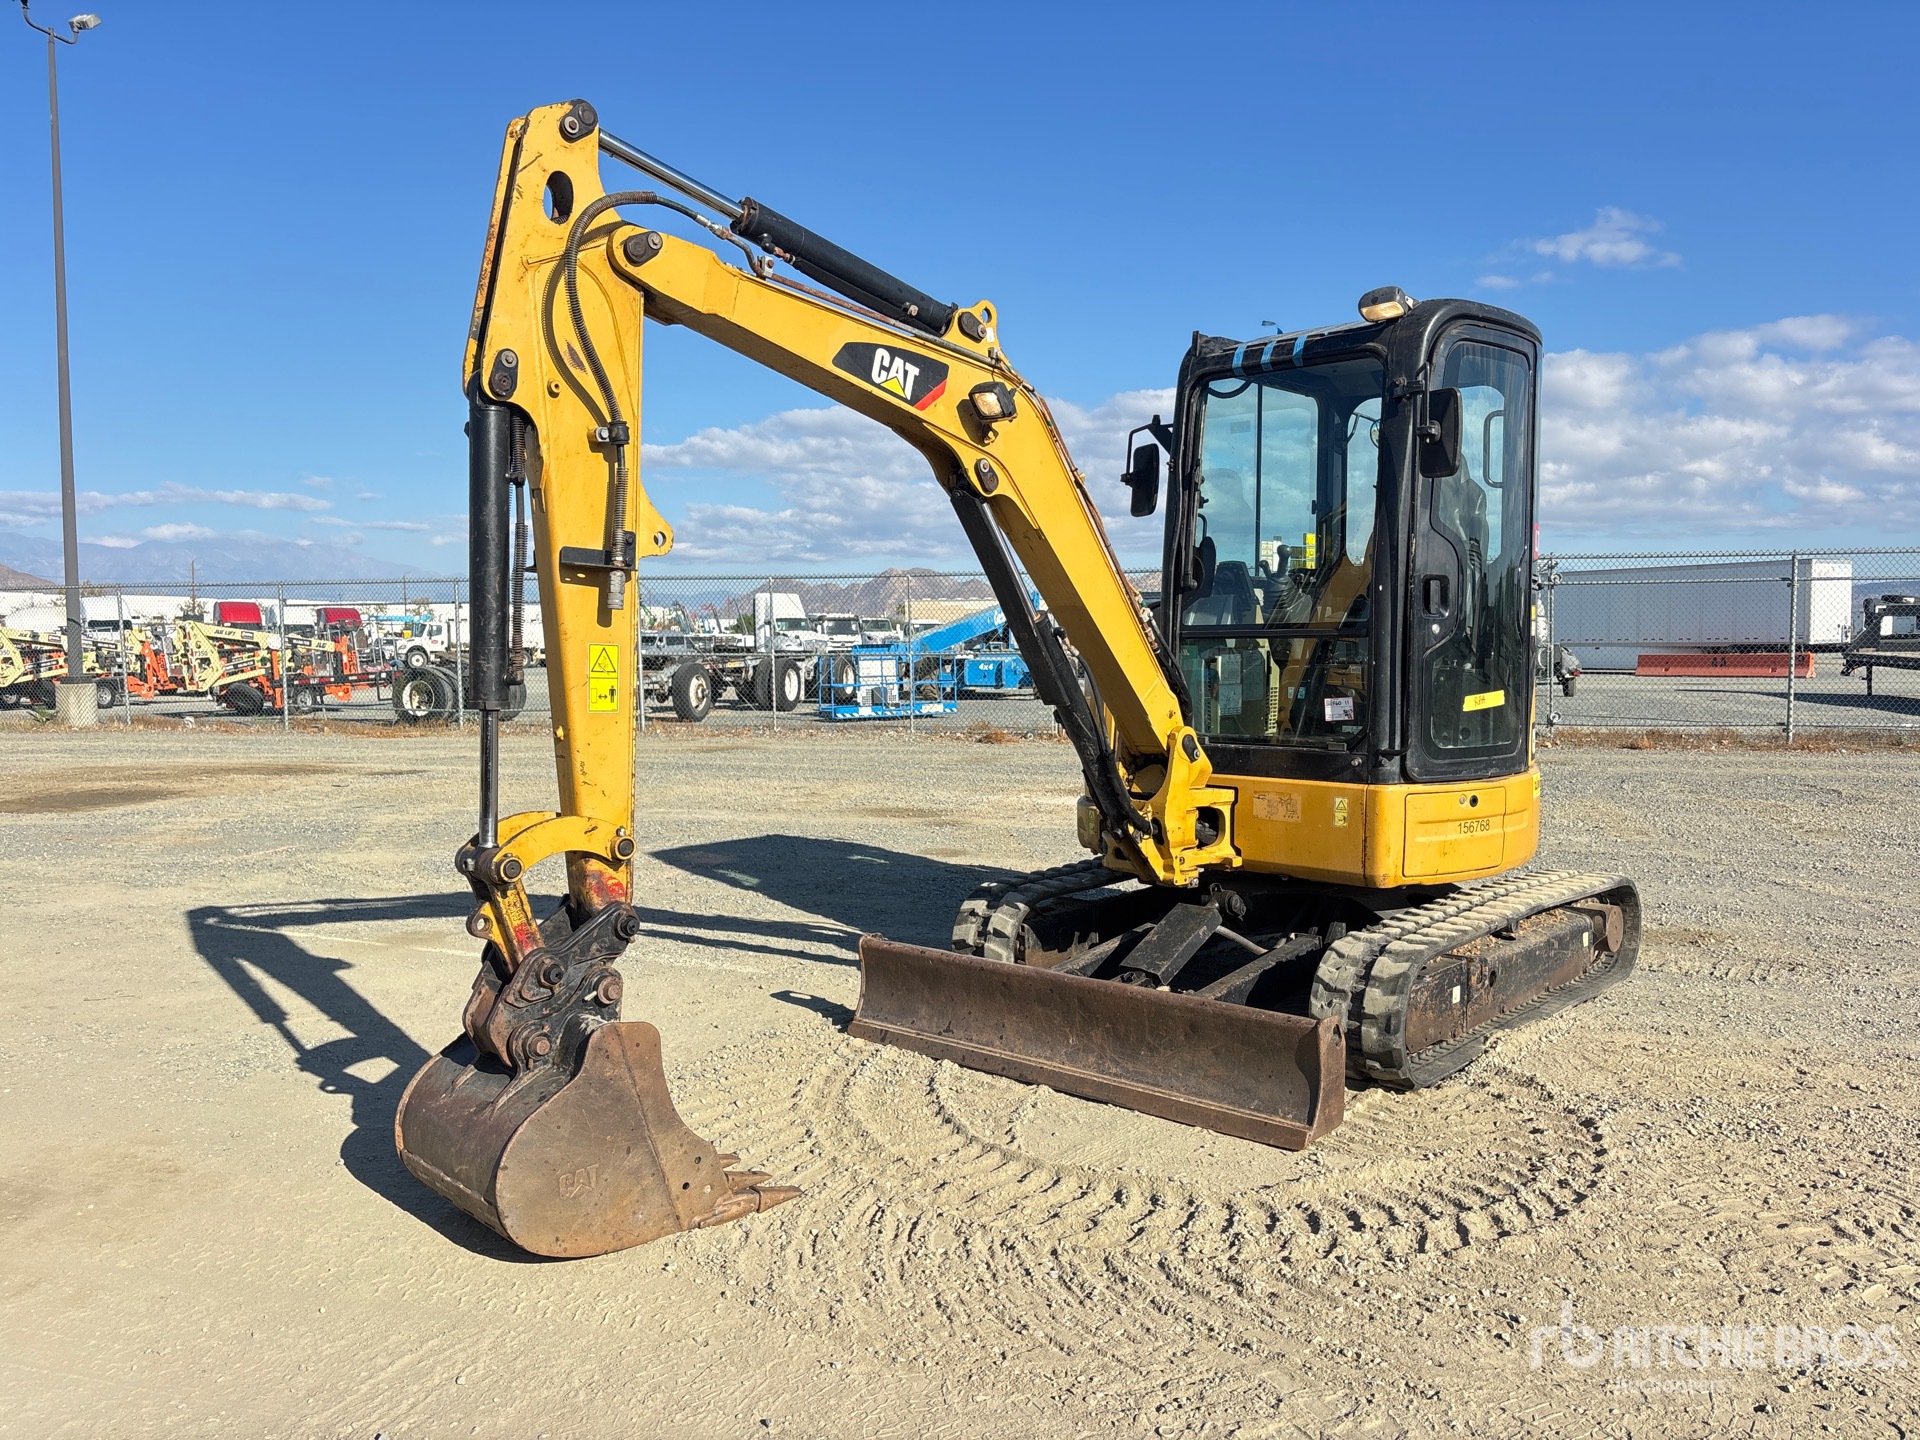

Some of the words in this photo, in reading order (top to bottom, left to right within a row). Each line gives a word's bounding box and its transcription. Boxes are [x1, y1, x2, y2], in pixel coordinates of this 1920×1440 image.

[871, 348, 920, 400] CAT
[1457, 819, 1490, 835] 156768
[560, 1163, 599, 1199] CAT
